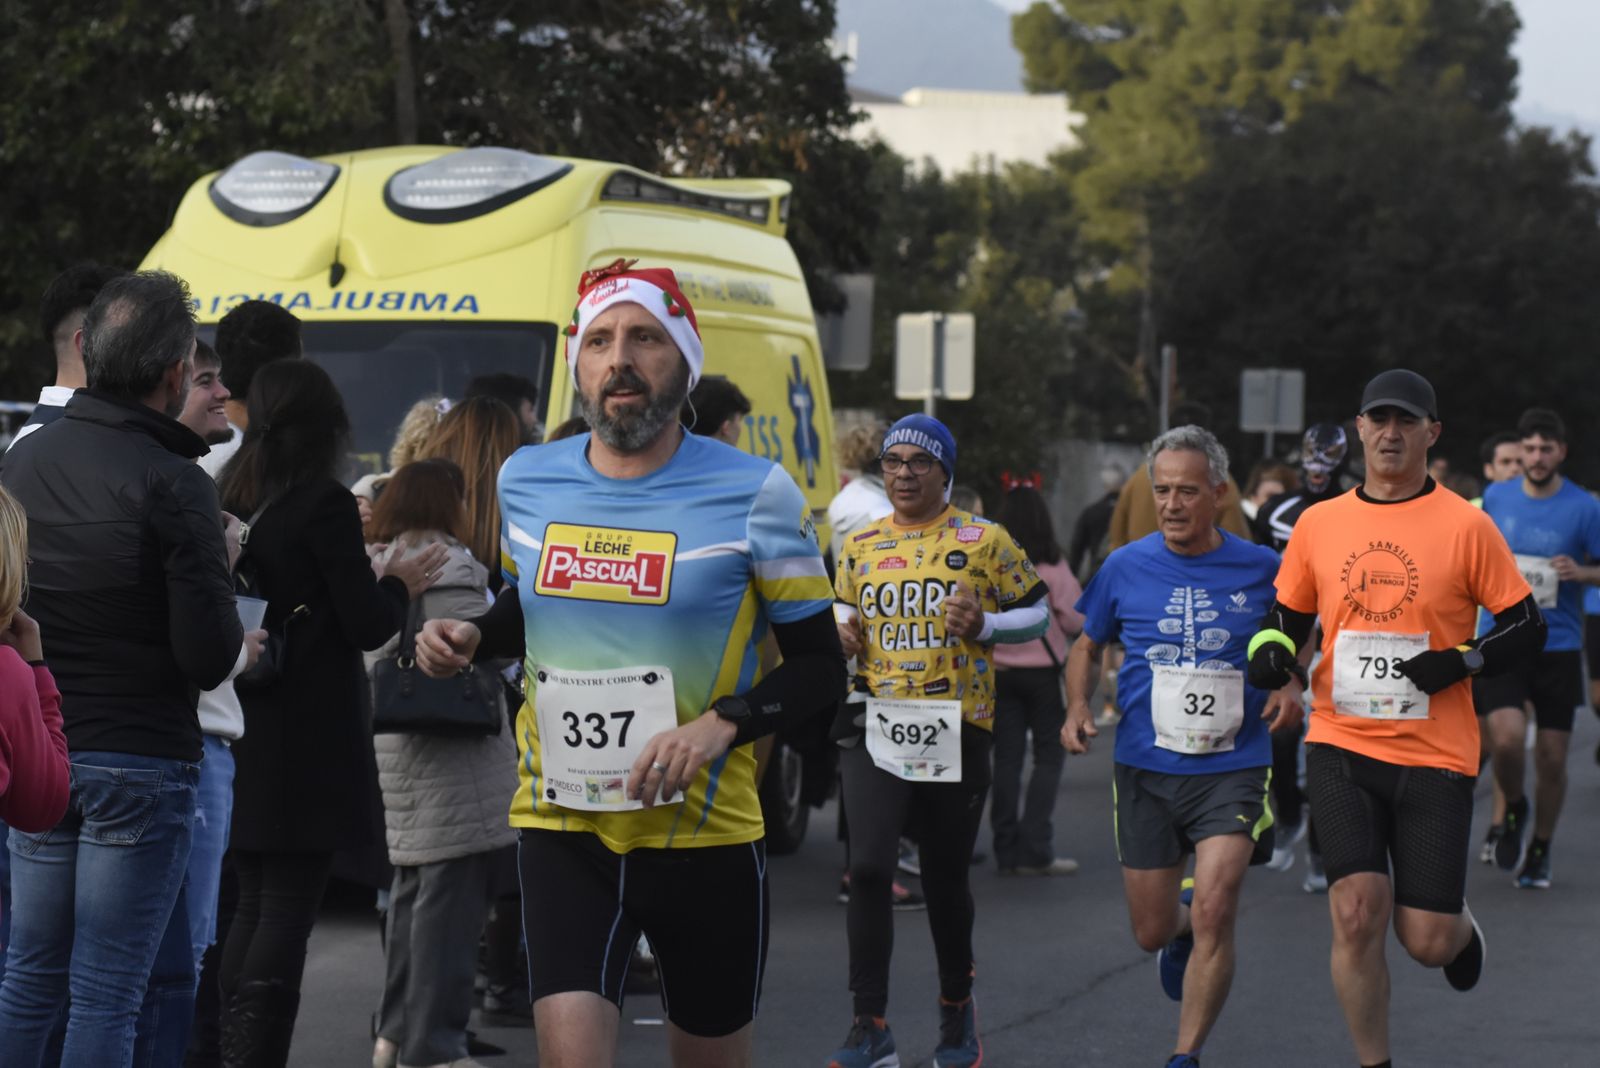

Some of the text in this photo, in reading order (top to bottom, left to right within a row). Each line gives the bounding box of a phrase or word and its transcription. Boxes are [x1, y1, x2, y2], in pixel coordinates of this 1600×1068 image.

[584, 541, 631, 556] LECHE
[586, 532, 632, 543] GRUPO
[546, 551, 657, 592] PASCUAL
[1340, 551, 1357, 582] XXXV
[606, 673, 665, 686] CORDOA
[1359, 656, 1405, 680] 793
[1184, 692, 1216, 716] 32
[562, 710, 635, 749] 337
[891, 723, 938, 745] 692
